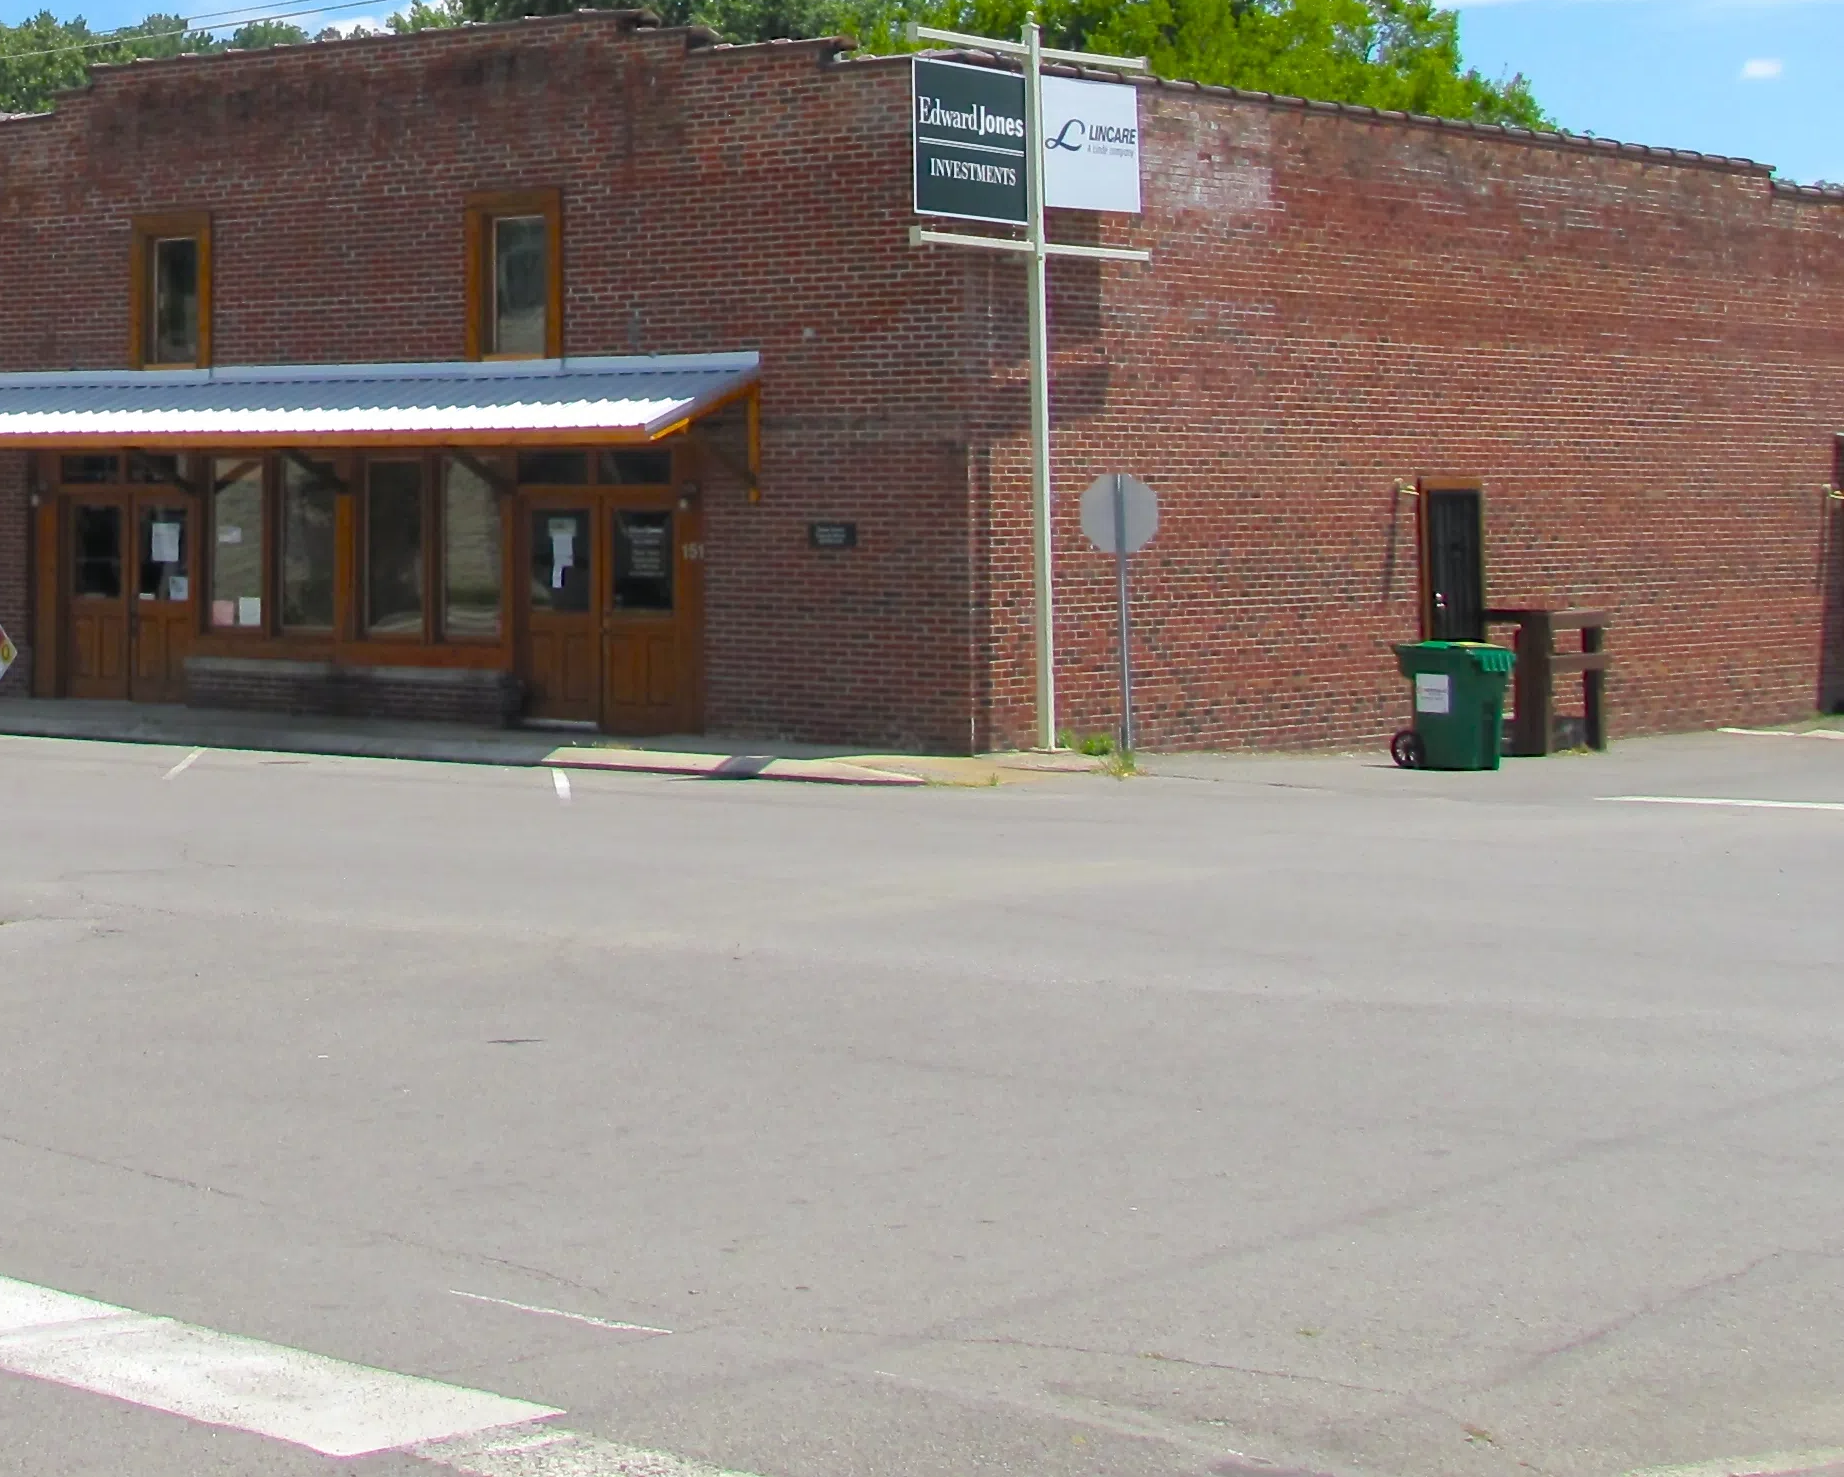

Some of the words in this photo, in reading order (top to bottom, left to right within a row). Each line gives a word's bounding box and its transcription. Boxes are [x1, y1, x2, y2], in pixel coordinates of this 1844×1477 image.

[1088, 124, 1137, 145] LINCARE
[1108, 147, 1135, 158] company
[930, 157, 1017, 187] INVESTMENTS
[681, 542, 705, 560] 151
